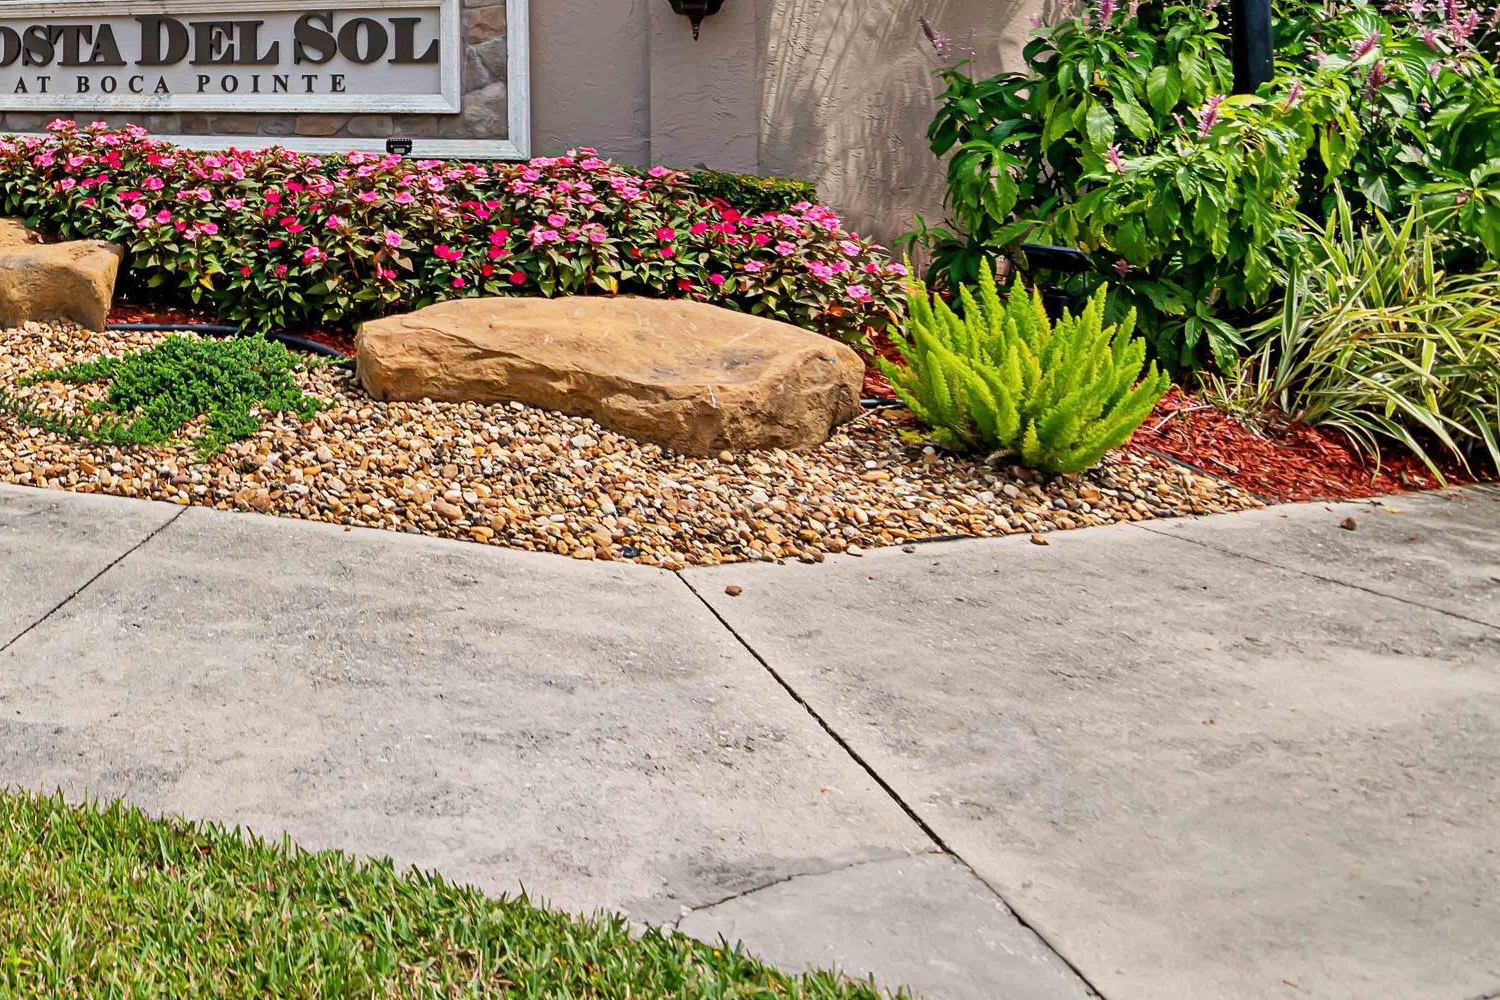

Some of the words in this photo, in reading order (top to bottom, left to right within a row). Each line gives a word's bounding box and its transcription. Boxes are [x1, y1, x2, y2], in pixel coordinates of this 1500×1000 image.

[135, 13, 280, 66] DEL
[293, 10, 439, 64] SOL
[13, 74, 52, 94] AT
[76, 74, 171, 93] BOCA
[196, 73, 348, 93] POINTE
